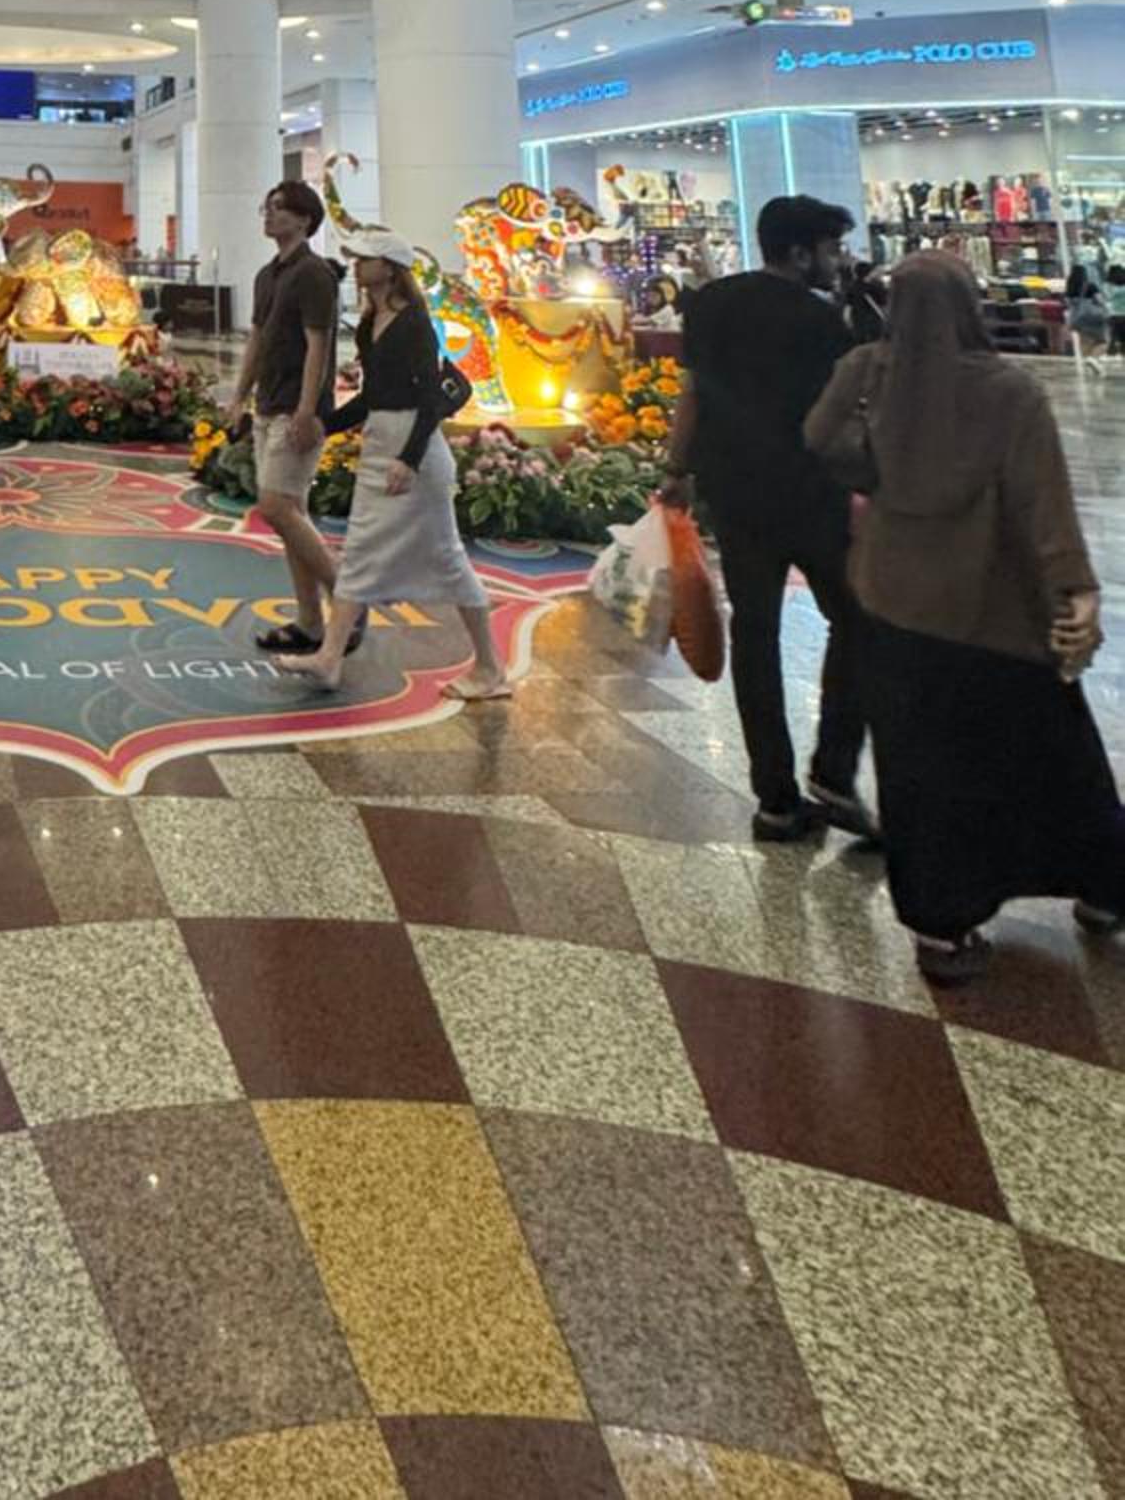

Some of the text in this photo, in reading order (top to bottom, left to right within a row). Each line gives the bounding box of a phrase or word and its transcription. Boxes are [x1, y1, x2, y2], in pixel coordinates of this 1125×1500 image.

[912, 43, 973, 63] POLO
[59, 660, 125, 679] OF
[142, 660, 303, 680] LIGHT
